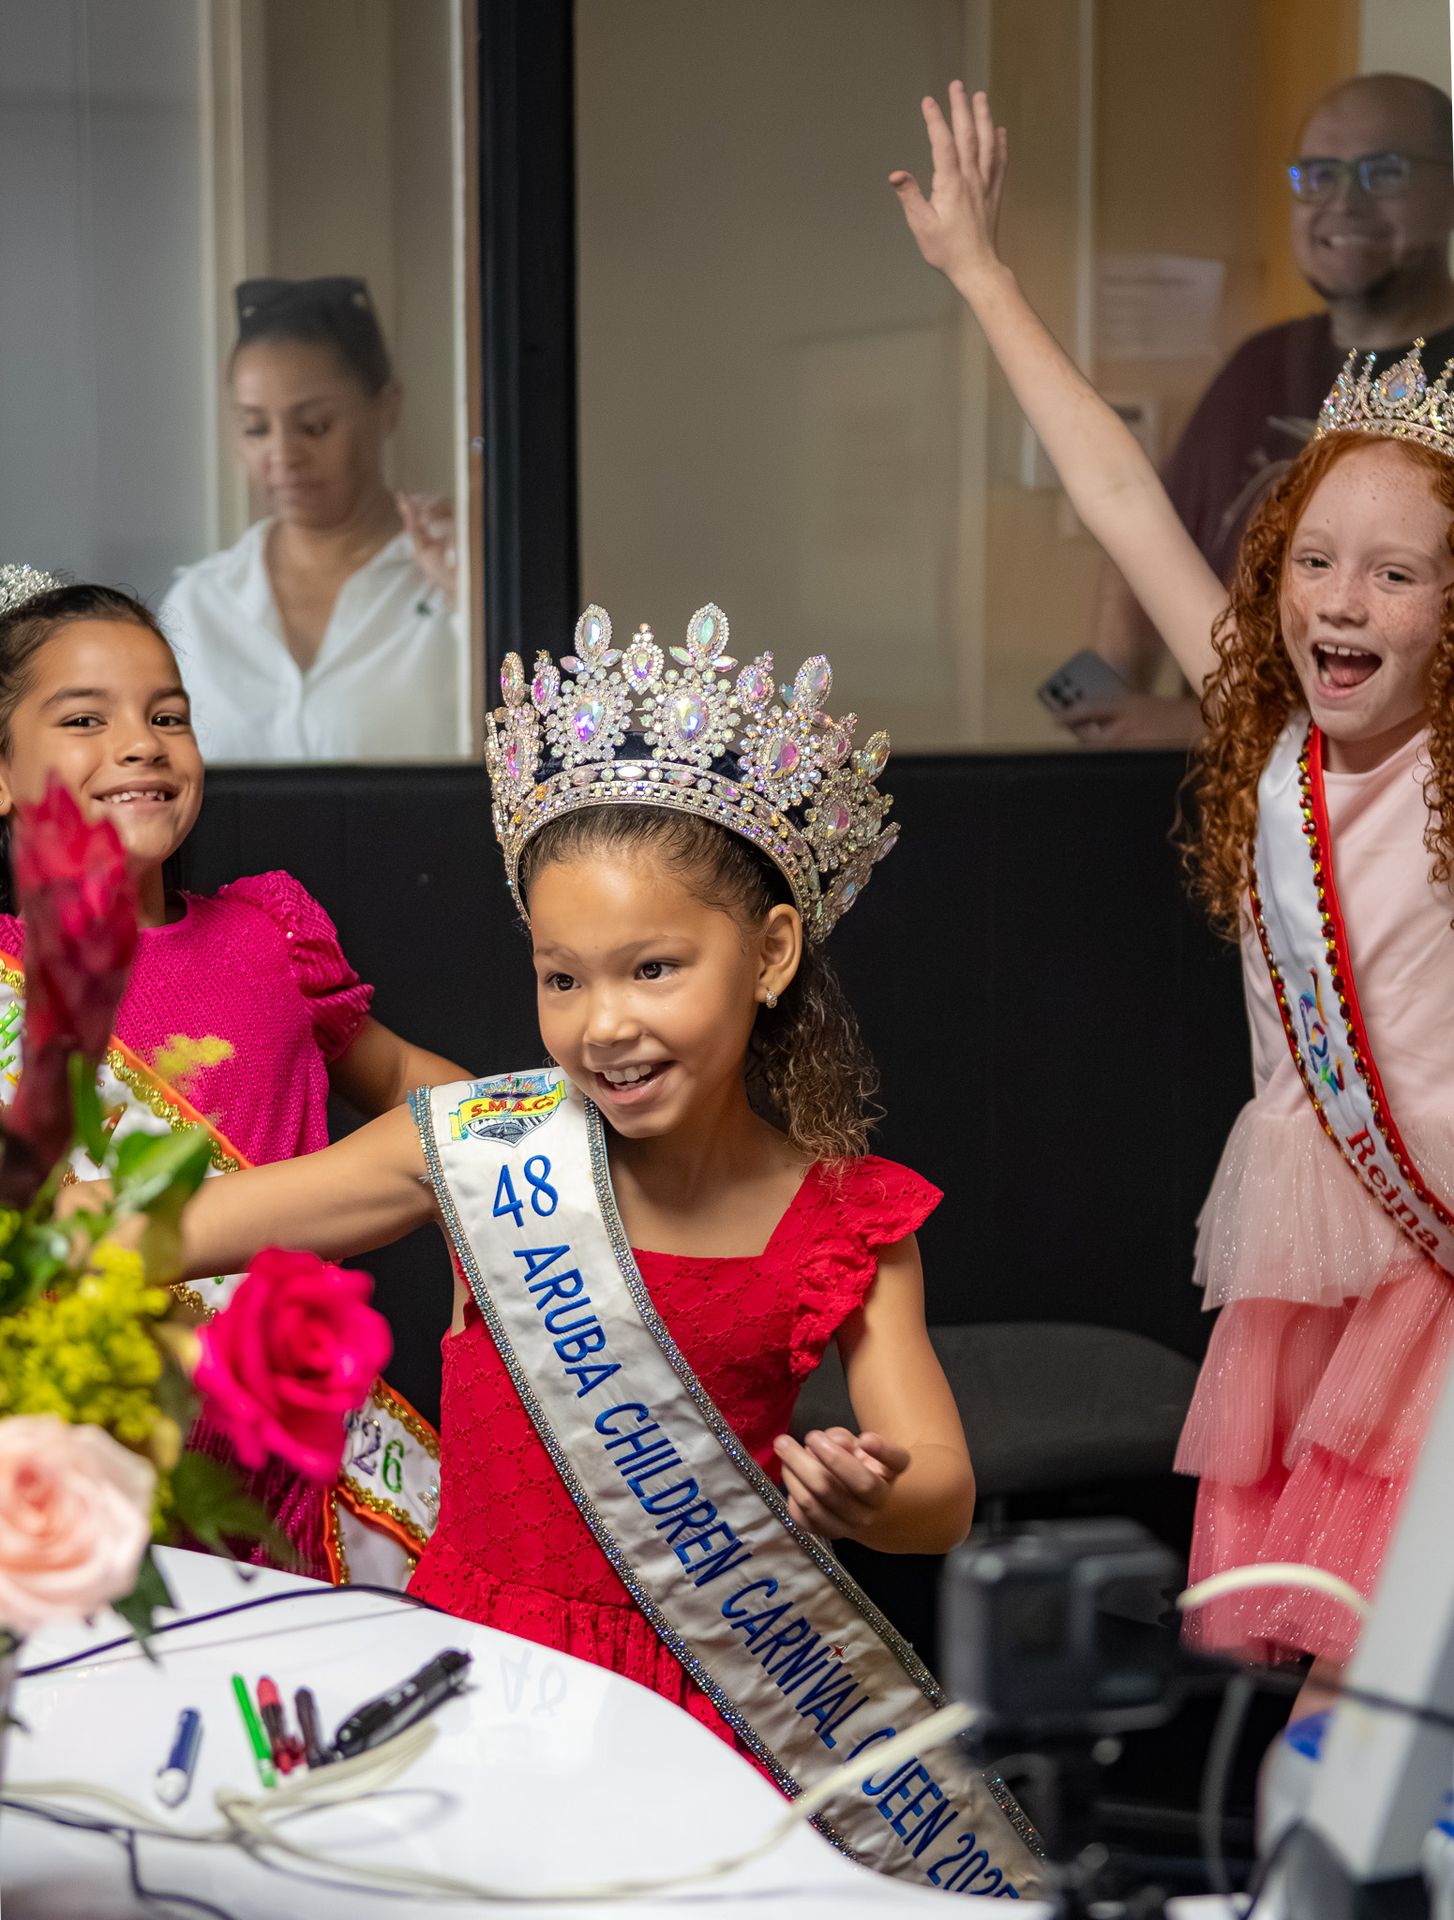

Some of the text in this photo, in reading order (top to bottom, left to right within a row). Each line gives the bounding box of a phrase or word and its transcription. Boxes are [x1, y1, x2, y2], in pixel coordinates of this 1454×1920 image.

[493, 1154, 557, 1227] 48
[1346, 1122, 1440, 1250] Reina
[514, 1246, 621, 1397] ARUBA
[347, 1411, 405, 1494] 26
[595, 1403, 751, 1587] CHILDREN
[721, 1578, 869, 1748] CARNIVAL
[928, 1832, 1018, 1898] 202
